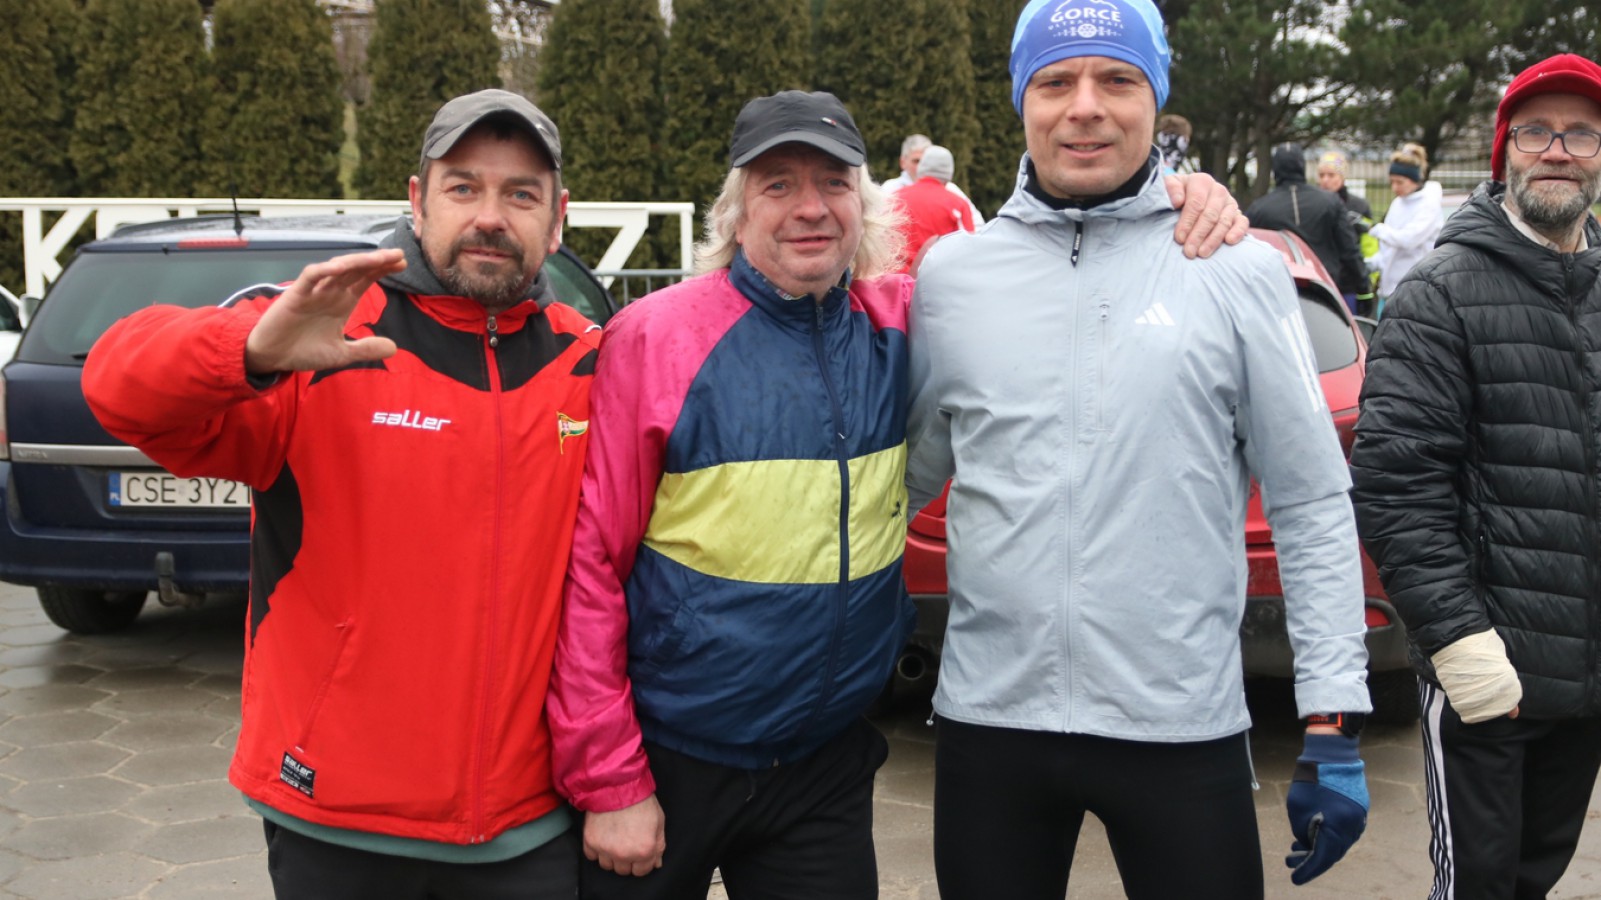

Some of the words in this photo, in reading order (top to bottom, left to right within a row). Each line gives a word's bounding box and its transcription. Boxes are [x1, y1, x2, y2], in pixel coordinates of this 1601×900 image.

[1050, 7, 1122, 23] GORCE
[371, 409, 451, 431] saller
[126, 476, 176, 504] CSE
